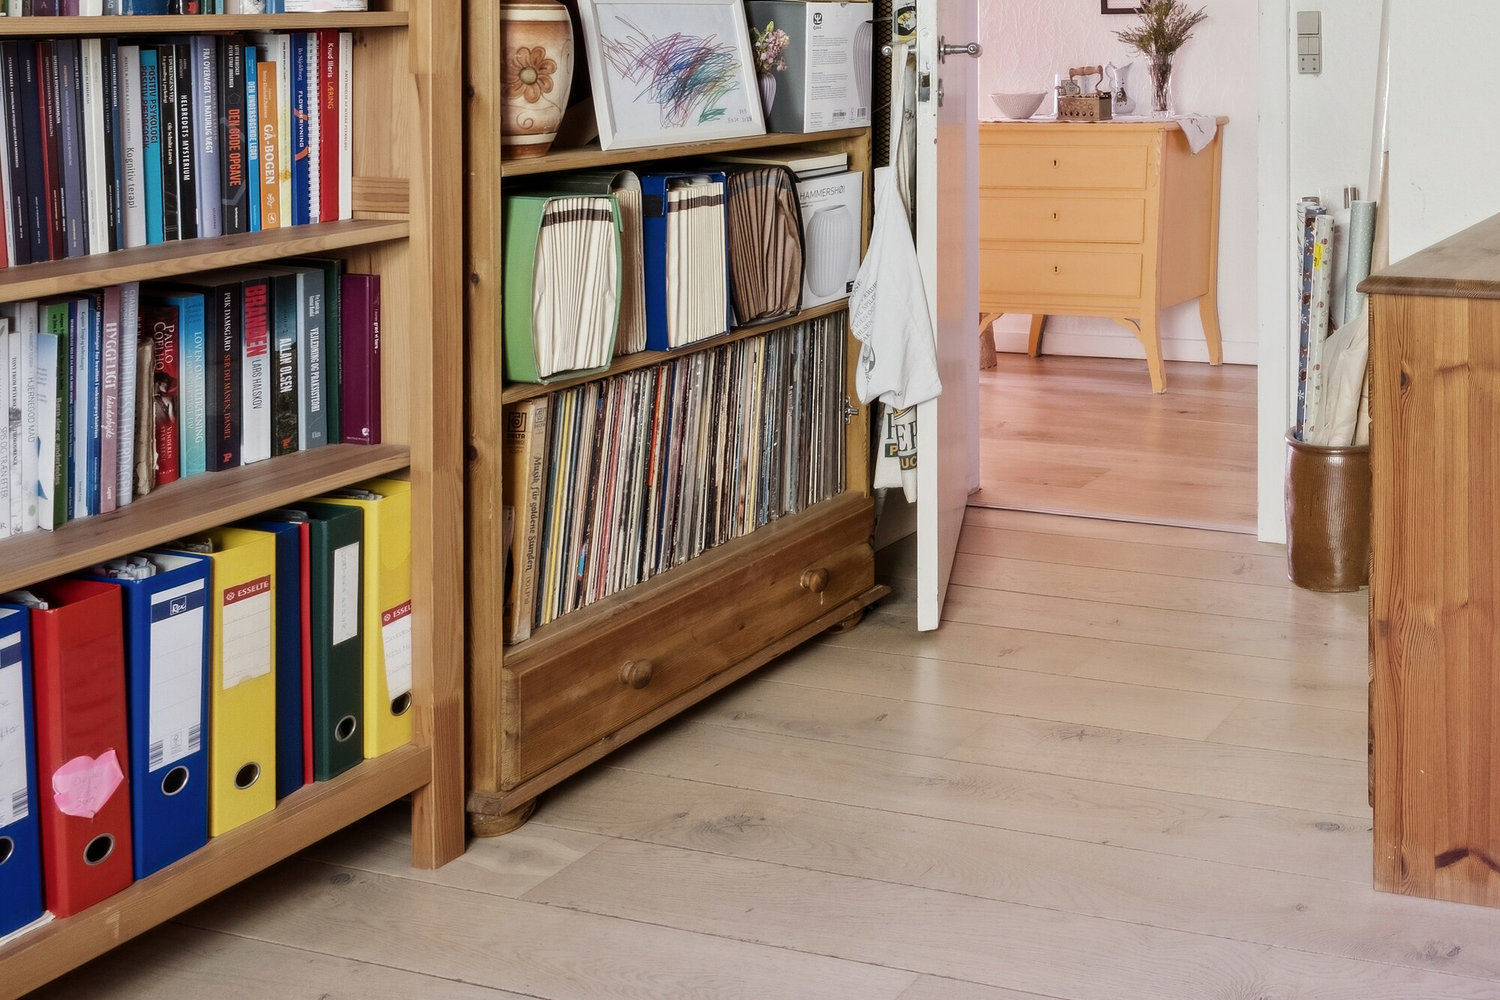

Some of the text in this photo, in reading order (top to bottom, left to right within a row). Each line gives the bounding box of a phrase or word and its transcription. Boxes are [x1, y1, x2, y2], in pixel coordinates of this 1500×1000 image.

[202, 48, 210, 60] FRA
[203, 61, 211, 93] OVERVÆGT
[148, 65, 158, 144] POSITIV PSYKOLOGI
[204, 105, 212, 135] NATURLIG
[180, 95, 190, 181] HELBREDETS MYSTERIUM
[228, 109, 241, 186] DEN GODE OPGAVE
[263, 124, 275, 184] GÅ-BOGEN
[125, 147, 136, 209] Kognitiv terapi
[800, 185, 846, 199] HAMMERSHØI
[223, 293, 231, 308] PUK
[224, 310, 233, 351] DAMSGÅRD
[244, 284, 267, 358] BRANDEN
[105, 323, 117, 389] HYGGELIGT
[153, 321, 165, 370] COELHO
[164, 324, 175, 364] PAULO
[194, 332, 202, 362] LOVEN
[310, 327, 319, 361] VEJLEDNING
[223, 355, 231, 368] SER
[224, 371, 231, 381] DU
[280, 338, 292, 393] ALLAN OLSEN
[311, 362, 319, 371] OG
[252, 359, 262, 409] LARS HALSKOV
[28, 425, 36, 443] MAD
[531, 457, 542, 484] Musik
[529, 502, 537, 534] goldene
[525, 536, 536, 572] Stunden
[237, 580, 269, 597] ESSELTE
